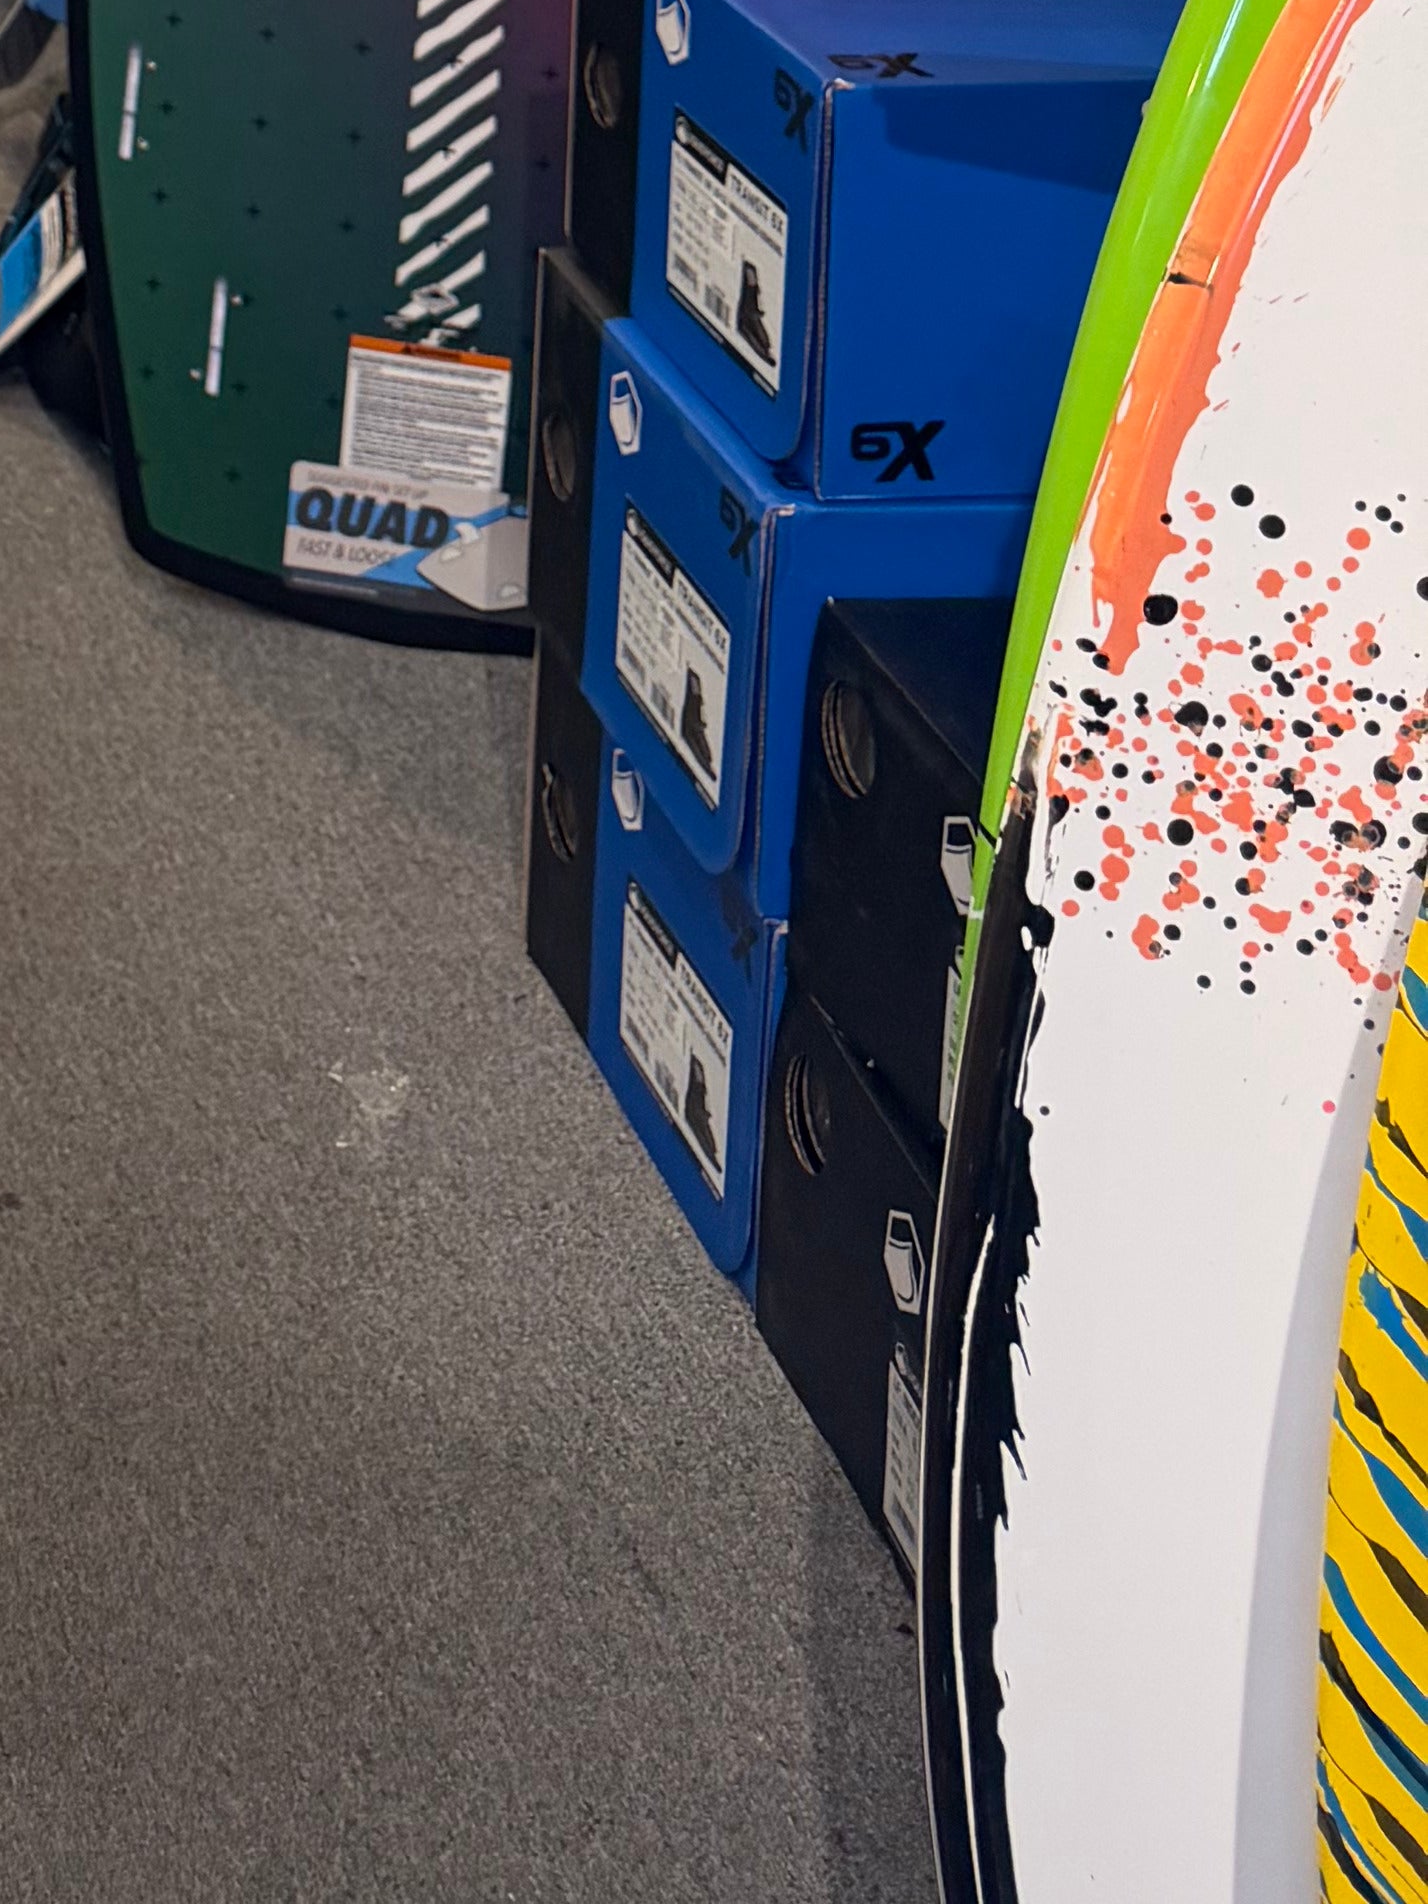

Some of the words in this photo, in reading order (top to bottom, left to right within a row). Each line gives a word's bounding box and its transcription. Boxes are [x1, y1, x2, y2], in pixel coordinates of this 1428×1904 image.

[850, 419, 947, 483] 6X
[295, 486, 450, 549] QUAD
[296, 537, 332, 557] FAST
